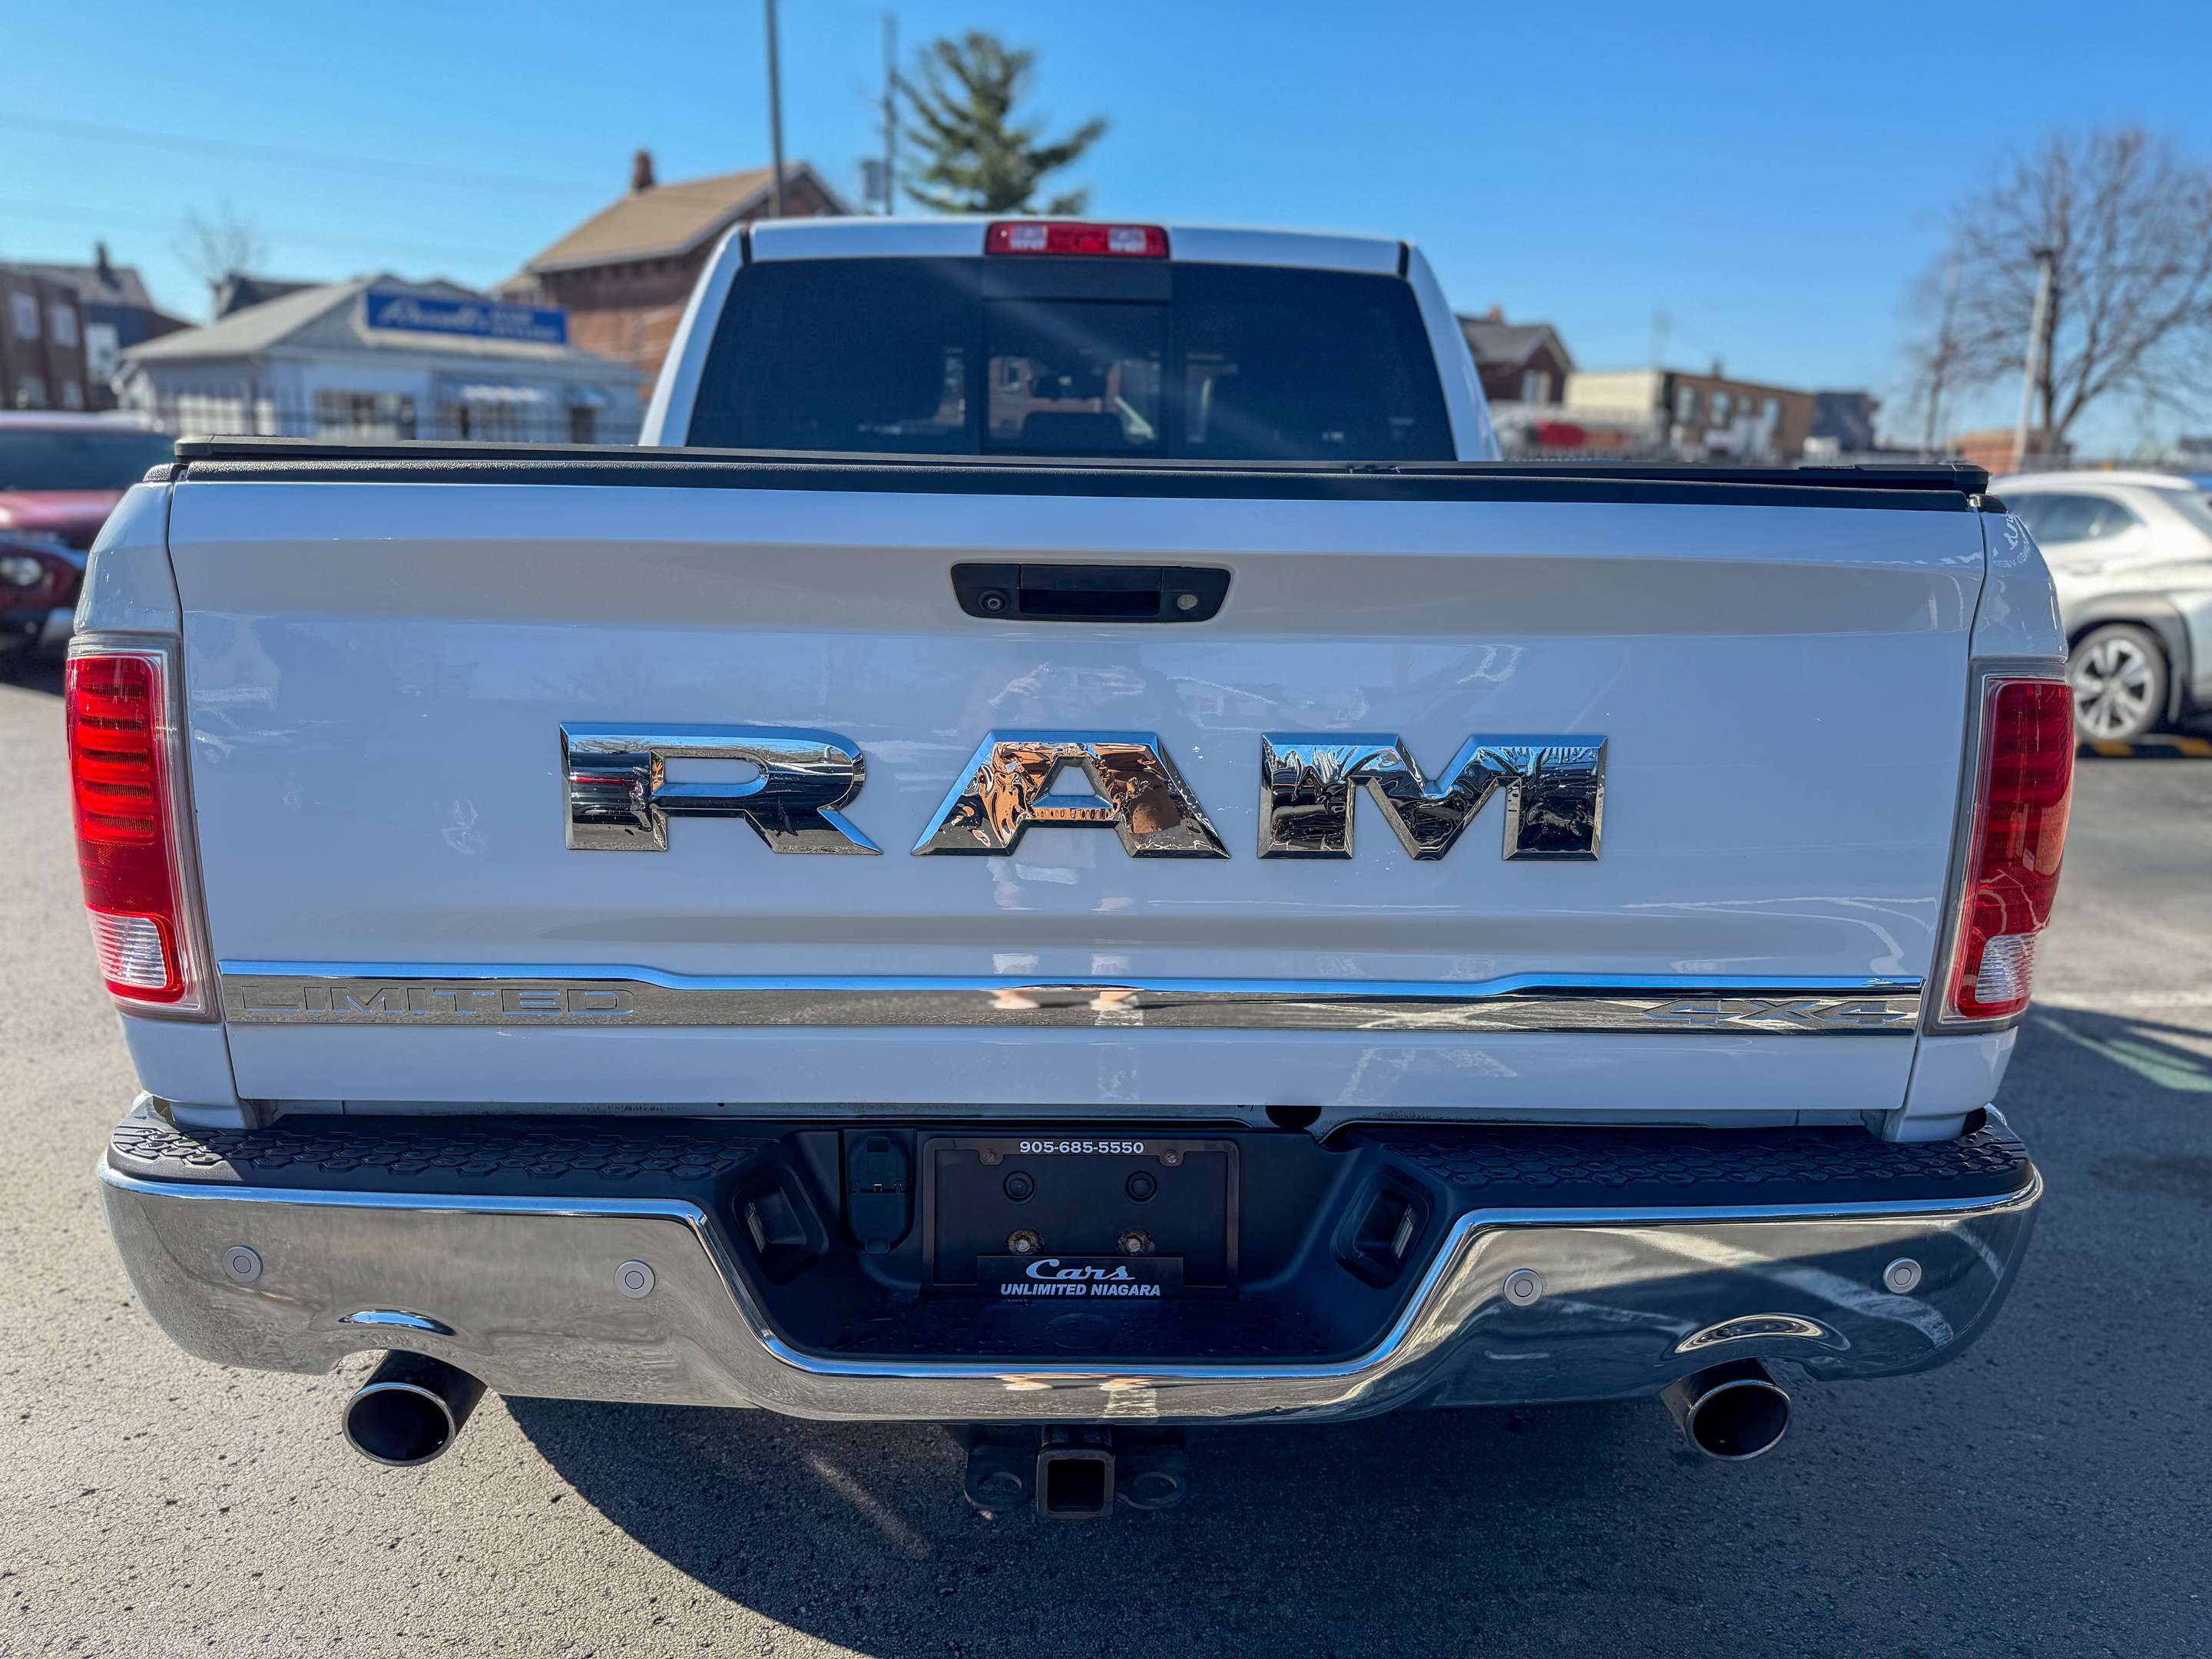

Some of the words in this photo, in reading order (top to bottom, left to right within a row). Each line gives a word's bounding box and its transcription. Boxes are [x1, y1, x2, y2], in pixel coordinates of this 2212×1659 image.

[561, 722, 1608, 860] RAM
[241, 985, 634, 1015] LIMITED
[1019, 1141, 1144, 1154] 905-685-5550
[1026, 1258, 1135, 1280] Cars
[1001, 1283, 1087, 1296] UNLIMITED
[1091, 1283, 1161, 1296] NIAGARA
